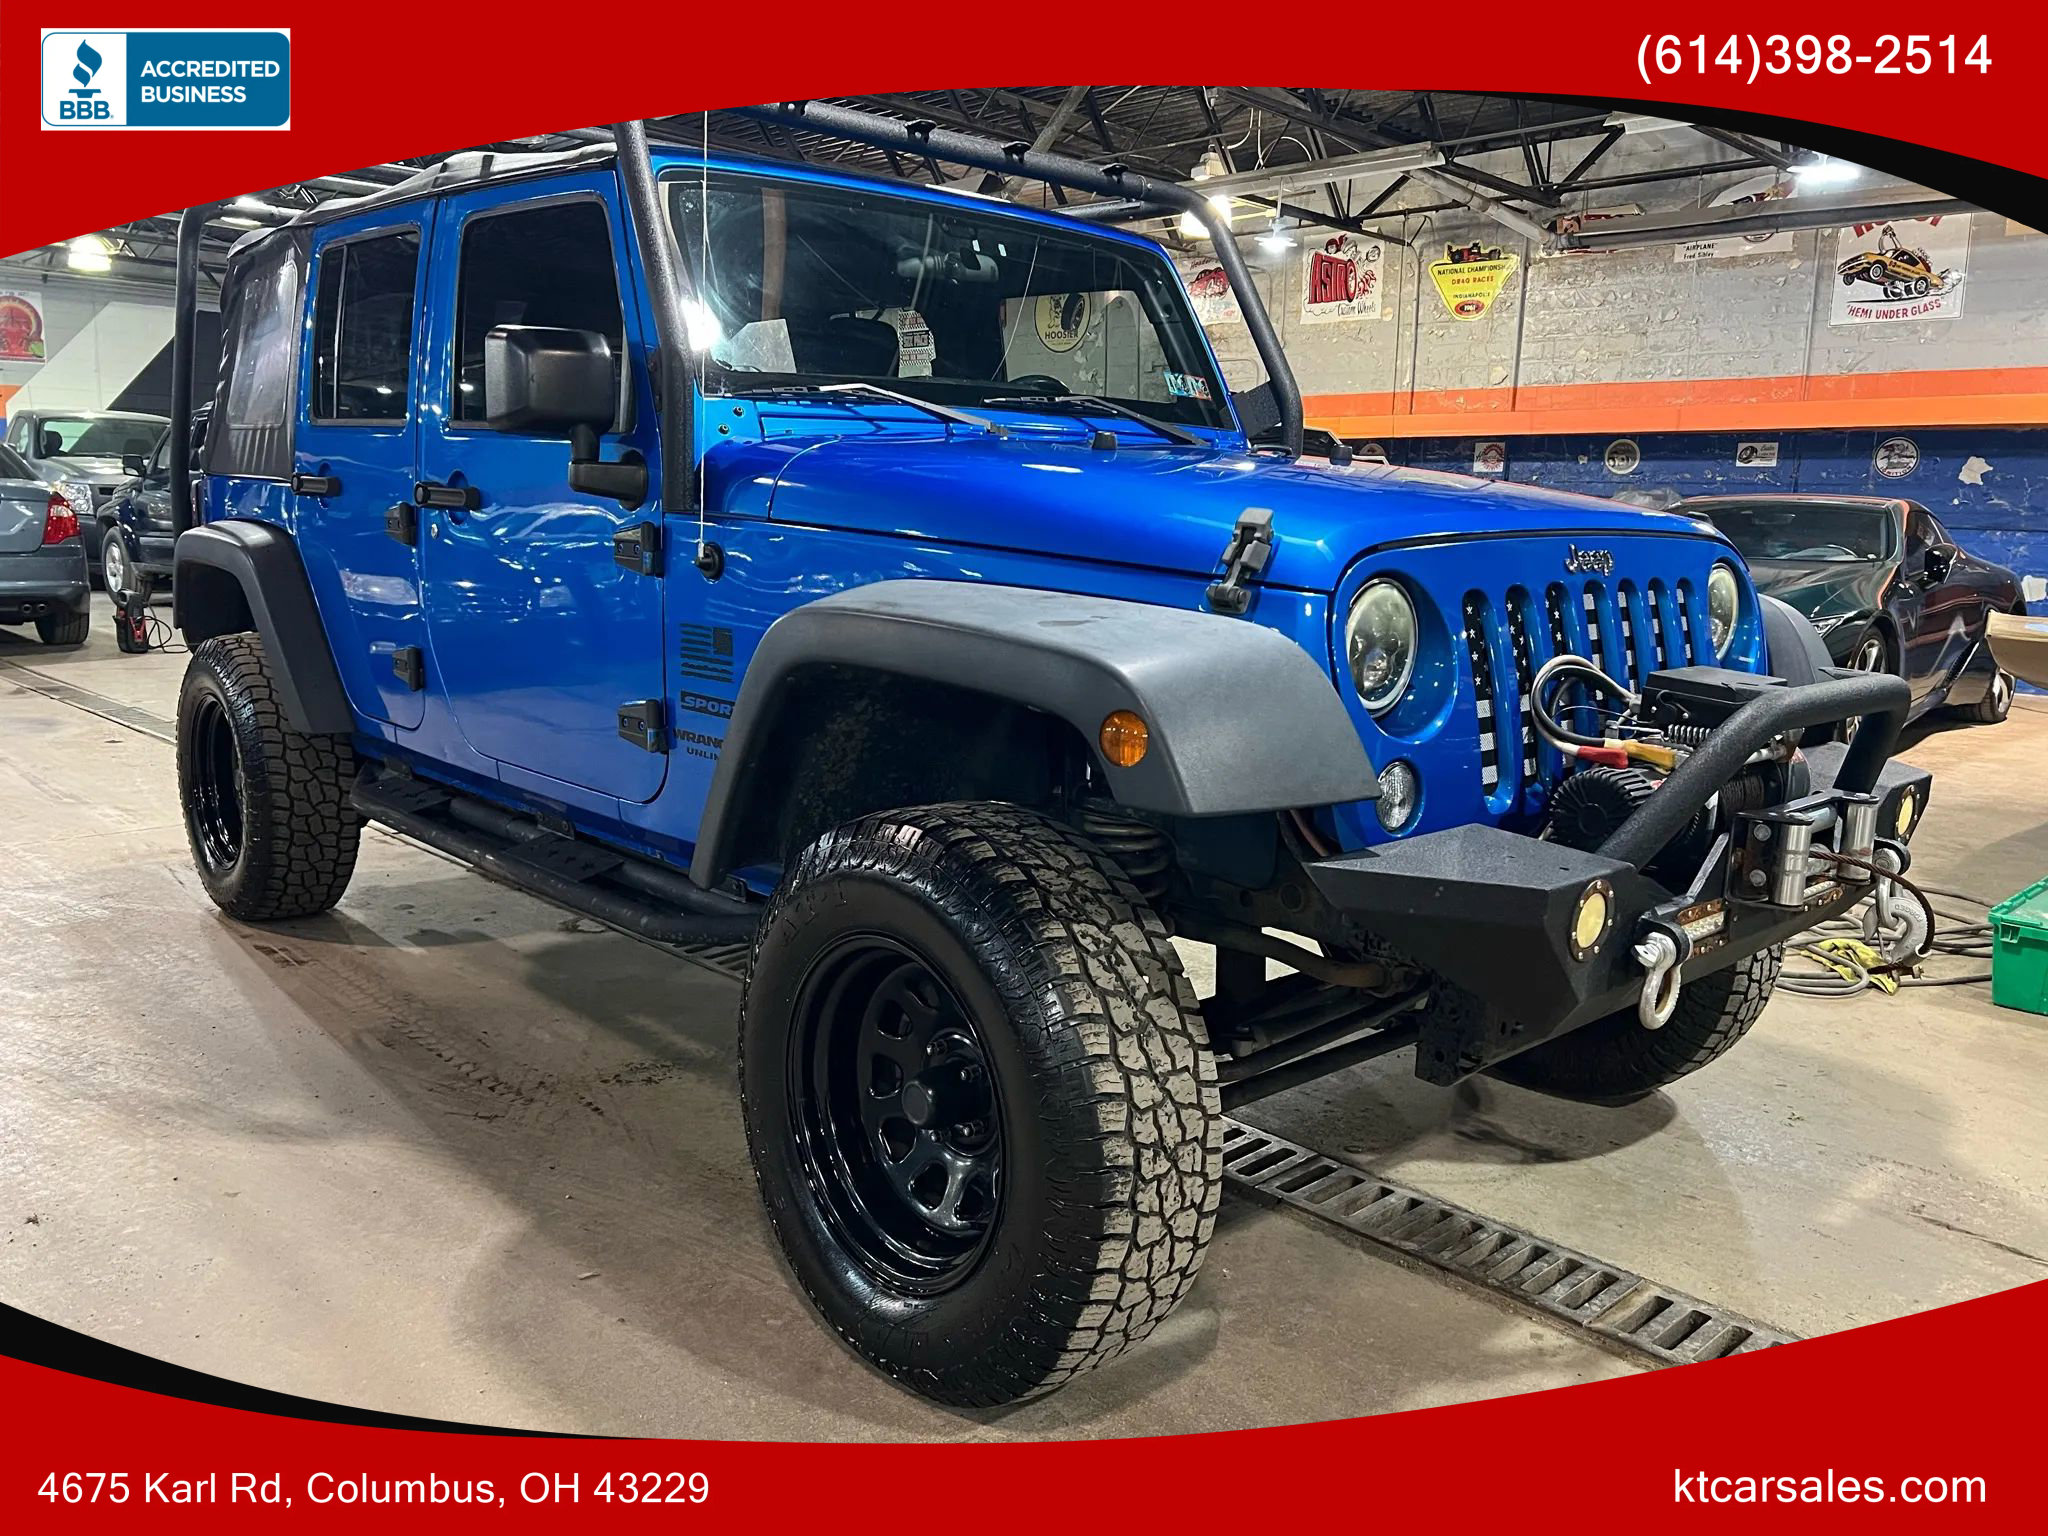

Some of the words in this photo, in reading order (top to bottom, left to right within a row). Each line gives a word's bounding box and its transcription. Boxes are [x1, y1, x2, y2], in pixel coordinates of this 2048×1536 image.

[1308, 250, 1357, 303] ASTRO
[1437, 267, 1466, 276] NATIONAL
[1472, 275, 1494, 283] RACES
[1875, 309, 1909, 320] UNDER
[1044, 330, 1079, 340] HOOSIER
[1564, 543, 1614, 577] Jeep
[683, 694, 735, 717] SPOR
